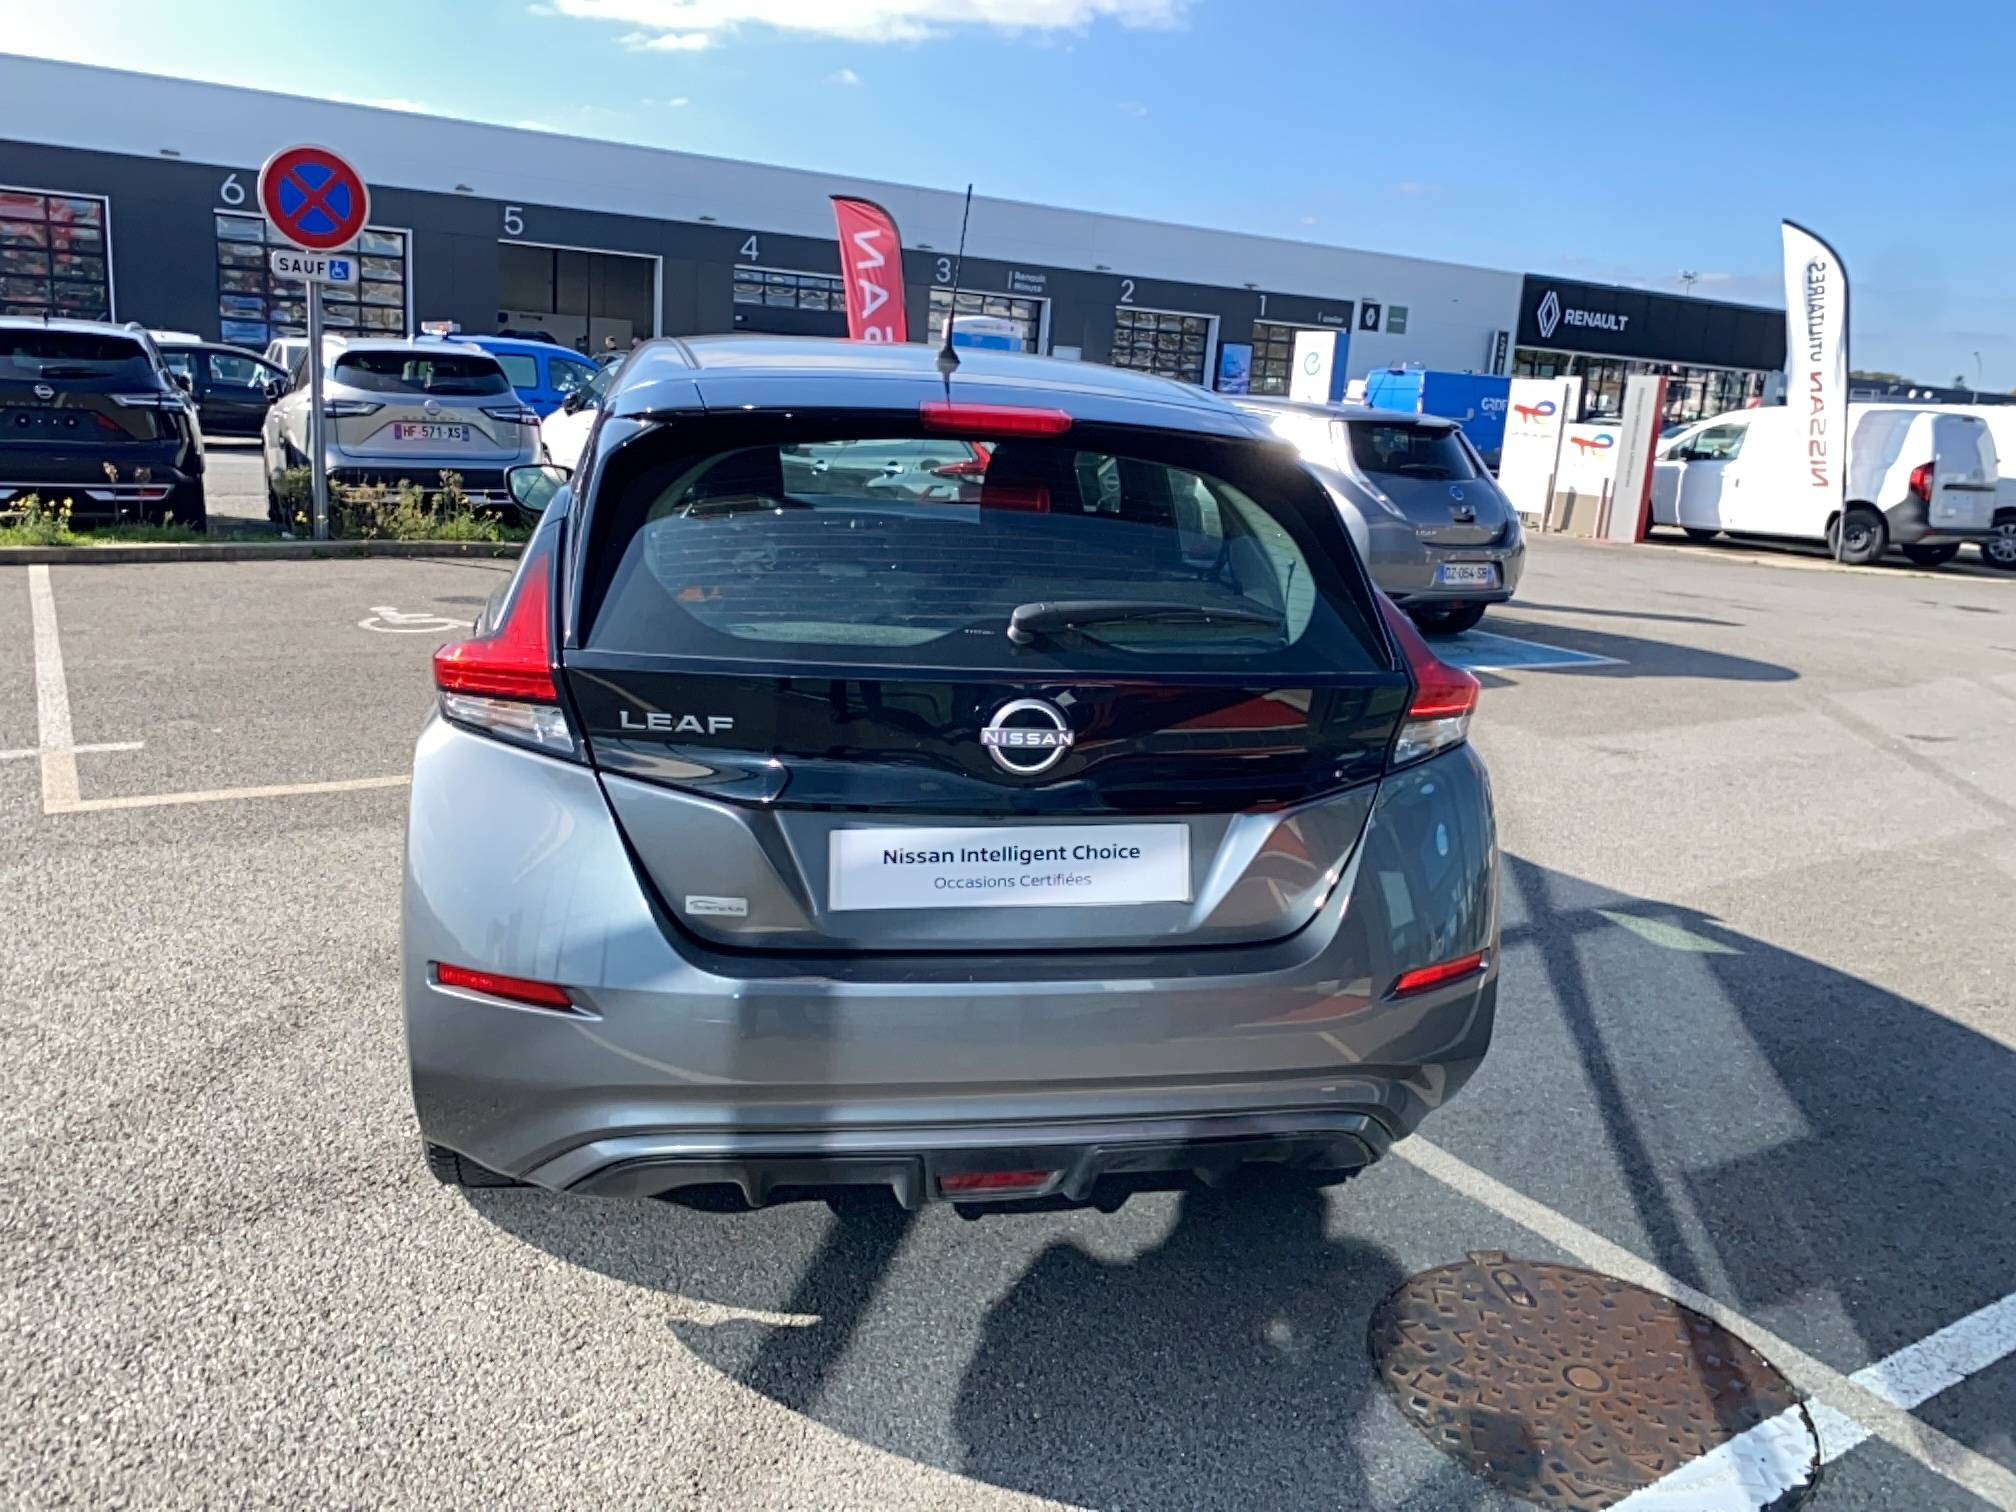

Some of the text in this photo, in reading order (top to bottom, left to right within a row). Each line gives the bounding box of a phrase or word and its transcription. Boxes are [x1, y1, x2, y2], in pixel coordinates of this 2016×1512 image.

[220, 173, 245, 205] 6
[504, 206, 523, 235] 5
[740, 235, 759, 261] 4
[279, 257, 326, 275] SAUF
[935, 257, 951, 283] 3
[1121, 279, 1135, 303] 2
[1259, 295, 1267, 317] 1
[1563, 308, 1629, 331] RENAULT
[619, 710, 734, 735] LEAF
[982, 730, 1073, 745] NISSAN
[883, 843, 1141, 865] Nissan Intelligent Choice
[934, 872, 1092, 889] Occasions Certifiées
